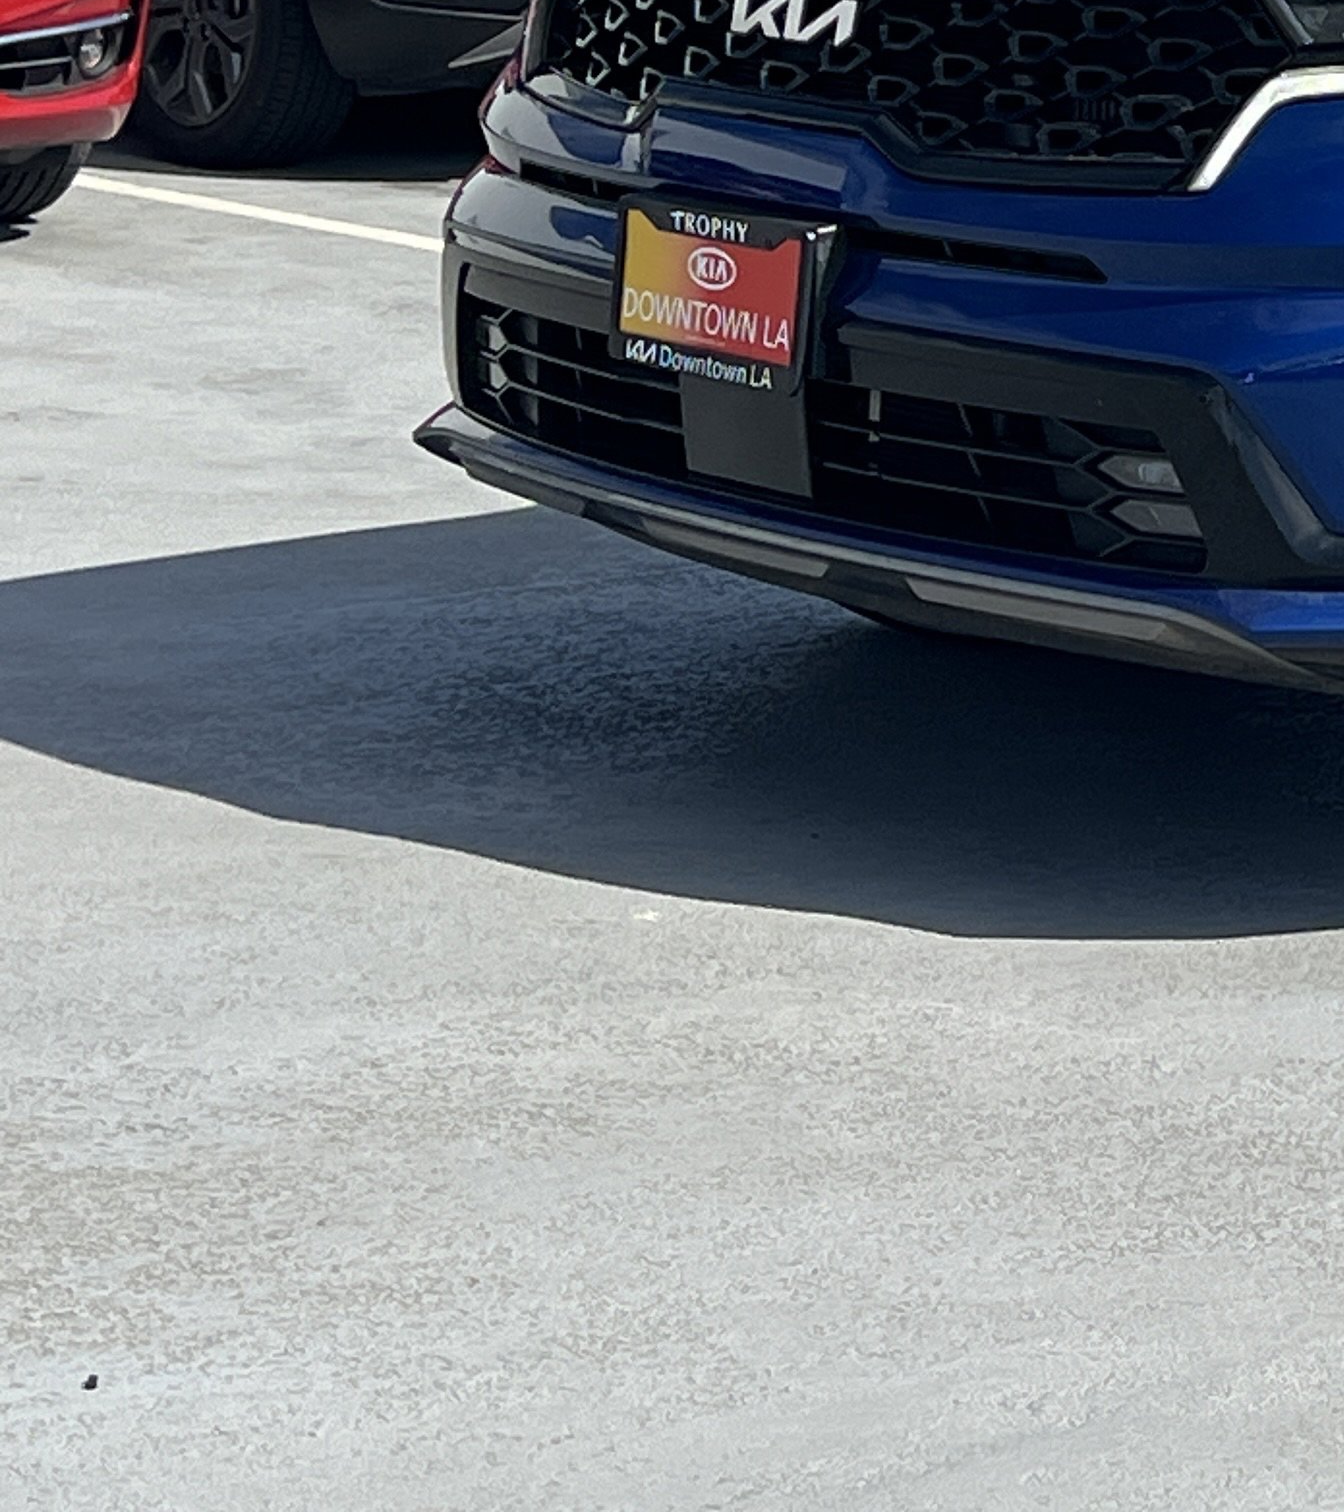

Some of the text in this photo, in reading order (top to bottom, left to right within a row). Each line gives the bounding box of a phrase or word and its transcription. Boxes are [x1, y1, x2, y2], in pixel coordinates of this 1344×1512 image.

[670, 210, 749, 242] TROPHY
[695, 254, 728, 281] KIA
[622, 288, 790, 352] DOWNTOWN LA
[626, 338, 772, 389] KIA Downtown LA
